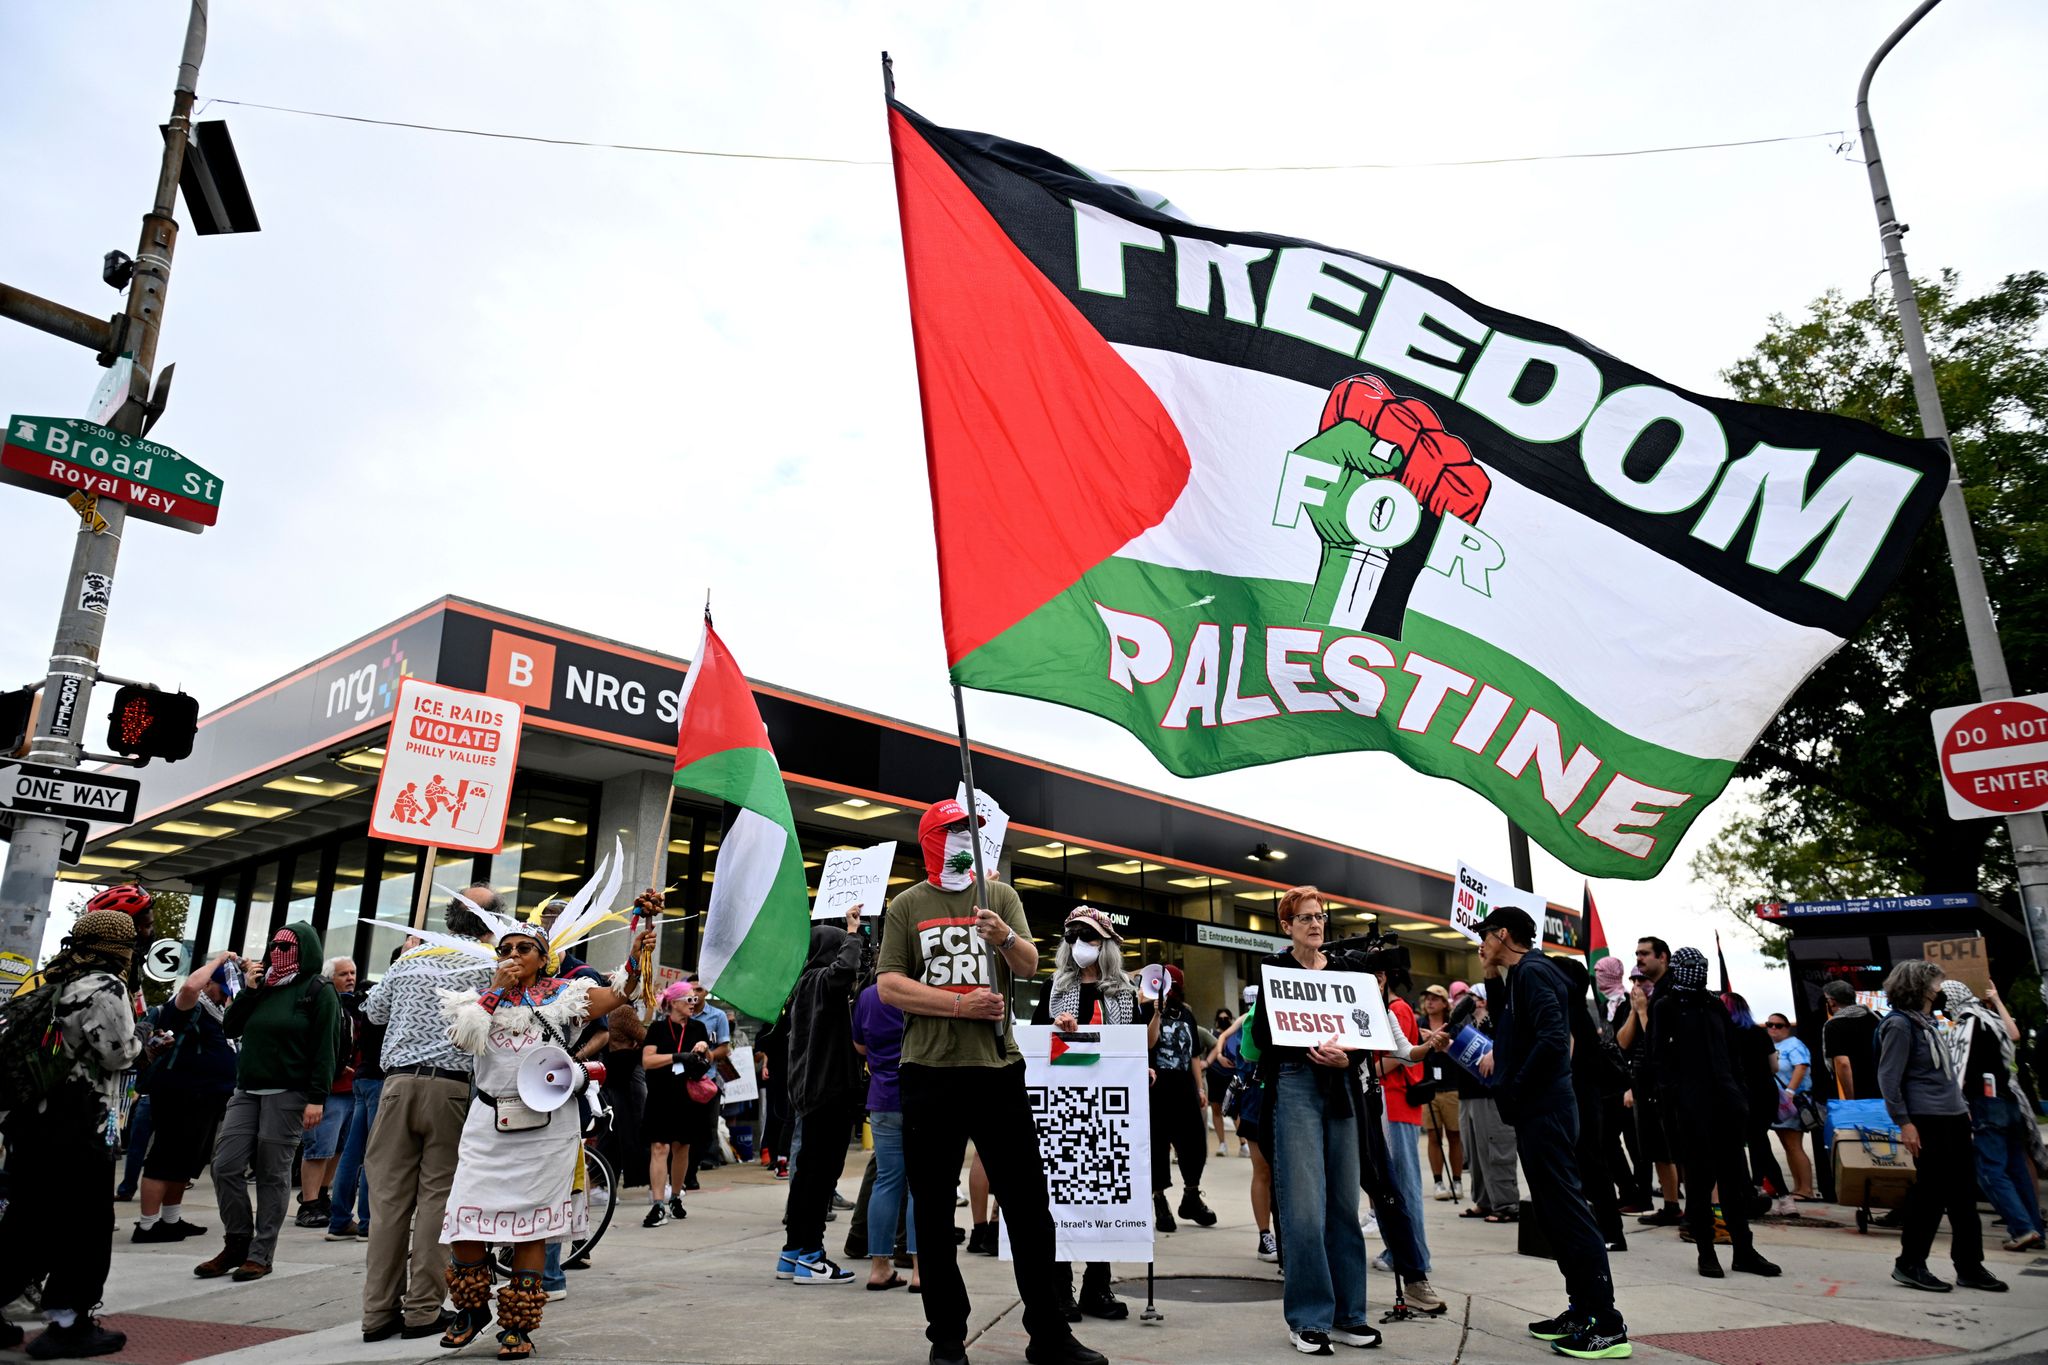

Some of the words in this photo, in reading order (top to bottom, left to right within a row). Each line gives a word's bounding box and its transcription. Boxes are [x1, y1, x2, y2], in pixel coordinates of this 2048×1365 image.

[1069, 198, 1924, 600] FREEDOM
[81, 423, 116, 441] 3500
[119, 434, 131, 447] S
[136, 441, 169, 458] 3600
[45, 426, 153, 481] Broad
[182, 472, 217, 500] St
[49, 460, 118, 494] Royal
[129, 483, 176, 513] Way
[1272, 451, 1505, 598] FOR
[326, 663, 377, 722] nrg
[508, 652, 534, 687] B
[565, 665, 646, 715] NRG
[450, 705, 503, 726] RAIDS
[414, 719, 497, 749] VIOLATE
[1093, 601, 1692, 860] PALESTINE
[1955, 727, 1987, 747] DO
[2001, 718, 2048, 740] NOT
[406, 741, 445, 758] PHILLY
[449, 750, 496, 766] VALUES
[16, 778, 64, 801] ONE
[73, 785, 120, 808] WAY
[1974, 769, 2048, 794] ENTER
[827, 875, 880, 890] BOMBING
[1460, 867, 1488, 897] Gaza:
[1458, 888, 1475, 911] AID
[1806, 904, 1841, 914] Express
[1110, 913, 1130, 926] ONLY
[1544, 916, 1565, 944] nrg
[1209, 931, 1234, 943] Entrance
[1234, 935, 1253, 946] Behind
[1253, 938, 1274, 951] Building
[660, 967, 681, 979] LET
[1269, 979, 1327, 1002] READY
[1331, 984, 1357, 1004] TO
[1275, 1011, 1345, 1034] RESIST
[1060, 1220, 1093, 1229] Israel's
[1095, 1220, 1112, 1228] War
[1115, 1219, 1147, 1228] Crimes
